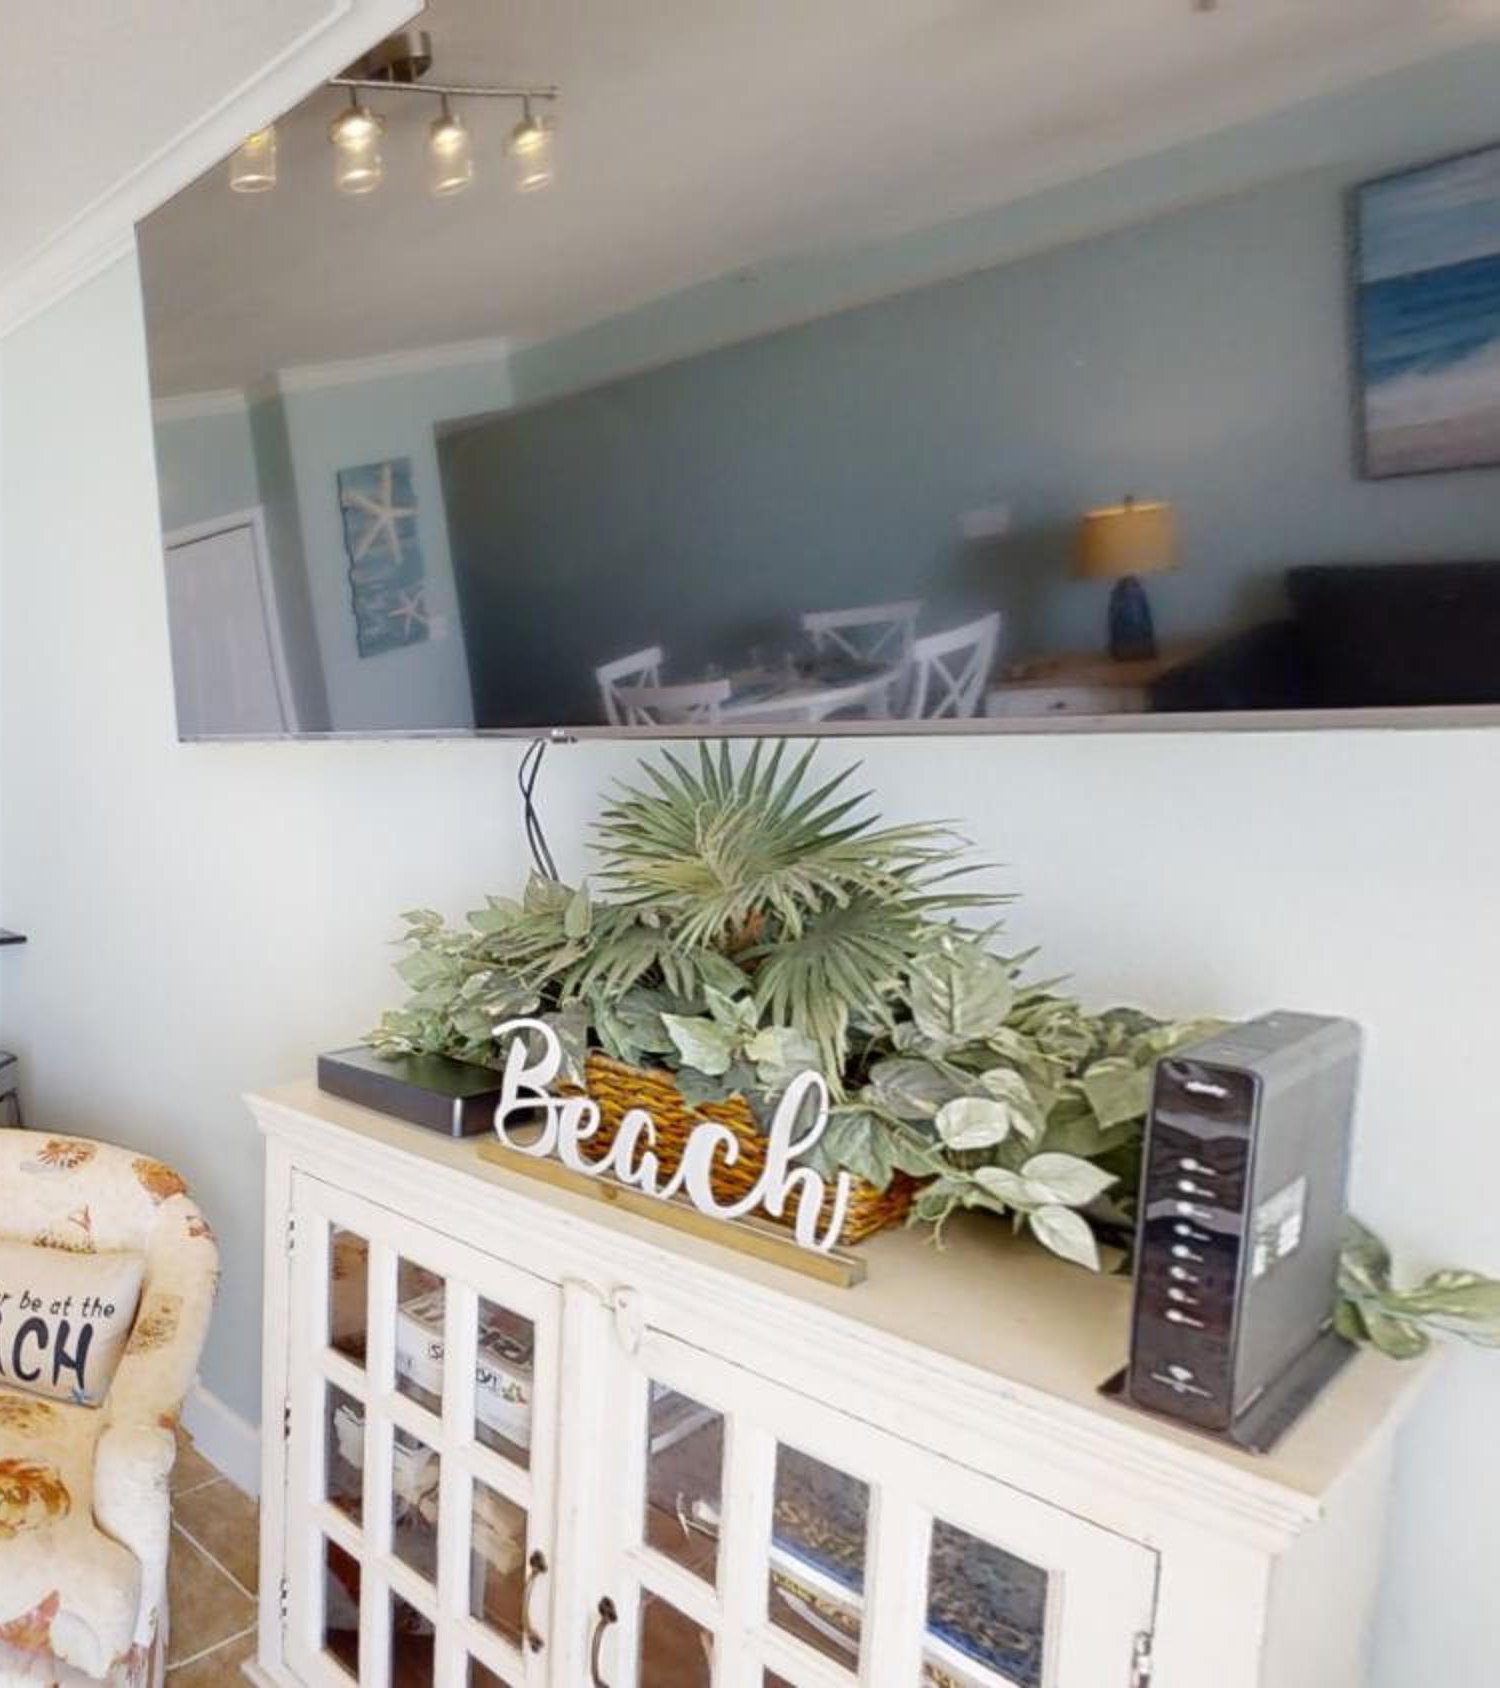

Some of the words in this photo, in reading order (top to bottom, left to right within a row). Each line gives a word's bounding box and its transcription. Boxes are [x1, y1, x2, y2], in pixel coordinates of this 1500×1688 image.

[491, 1017, 850, 1254] Beach
[20, 1289, 43, 1314] be
[49, 1299, 73, 1317] at
[81, 1297, 116, 1319] the
